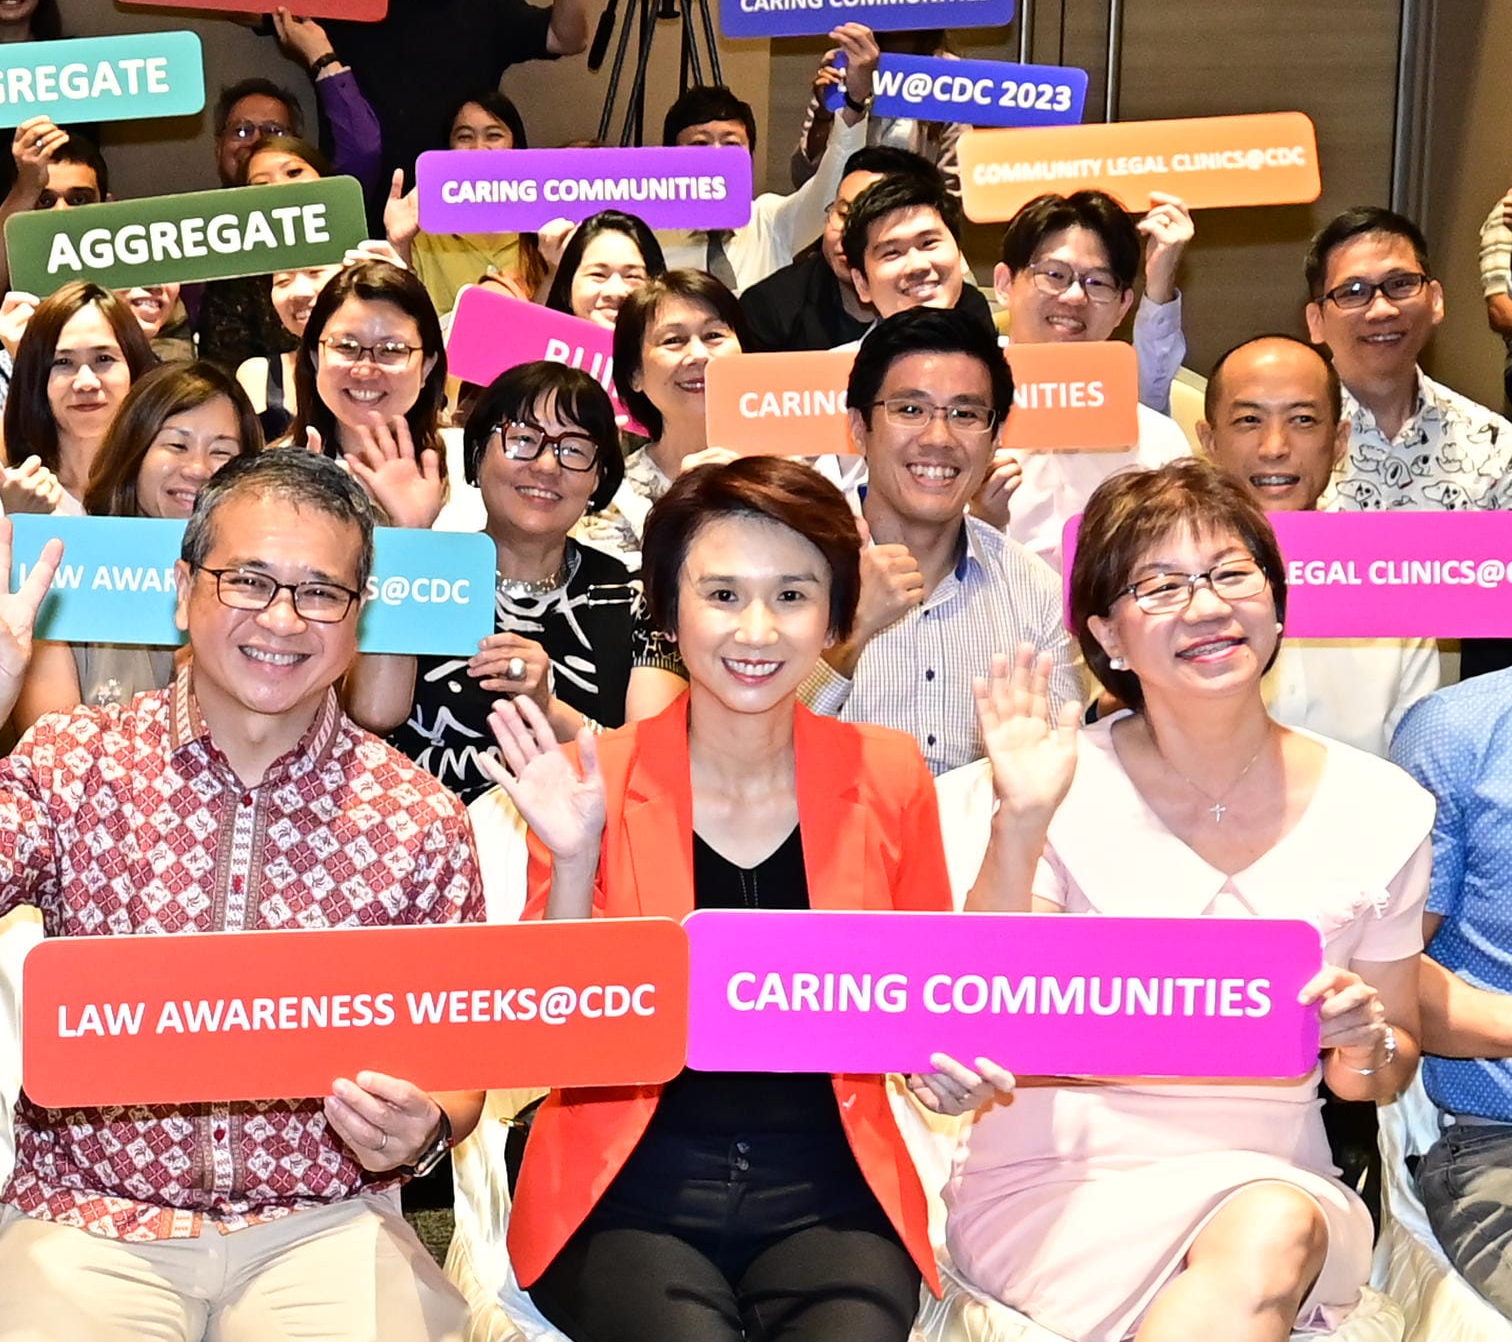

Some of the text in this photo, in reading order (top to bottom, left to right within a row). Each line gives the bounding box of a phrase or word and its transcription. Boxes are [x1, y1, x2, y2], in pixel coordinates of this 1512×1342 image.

[846, 68, 1072, 112] W@CDC 2023
[973, 145, 1305, 185] COMMUNITY LEGAL CLINICS@CDC
[442, 176, 727, 203] CARING COMMUNITIES
[48, 203, 330, 274] AGGREGATE
[57, 984, 656, 1037] LAW AWARENESS WEEKS@CDC
[727, 971, 1272, 1019] CARING COMMUNITIES
